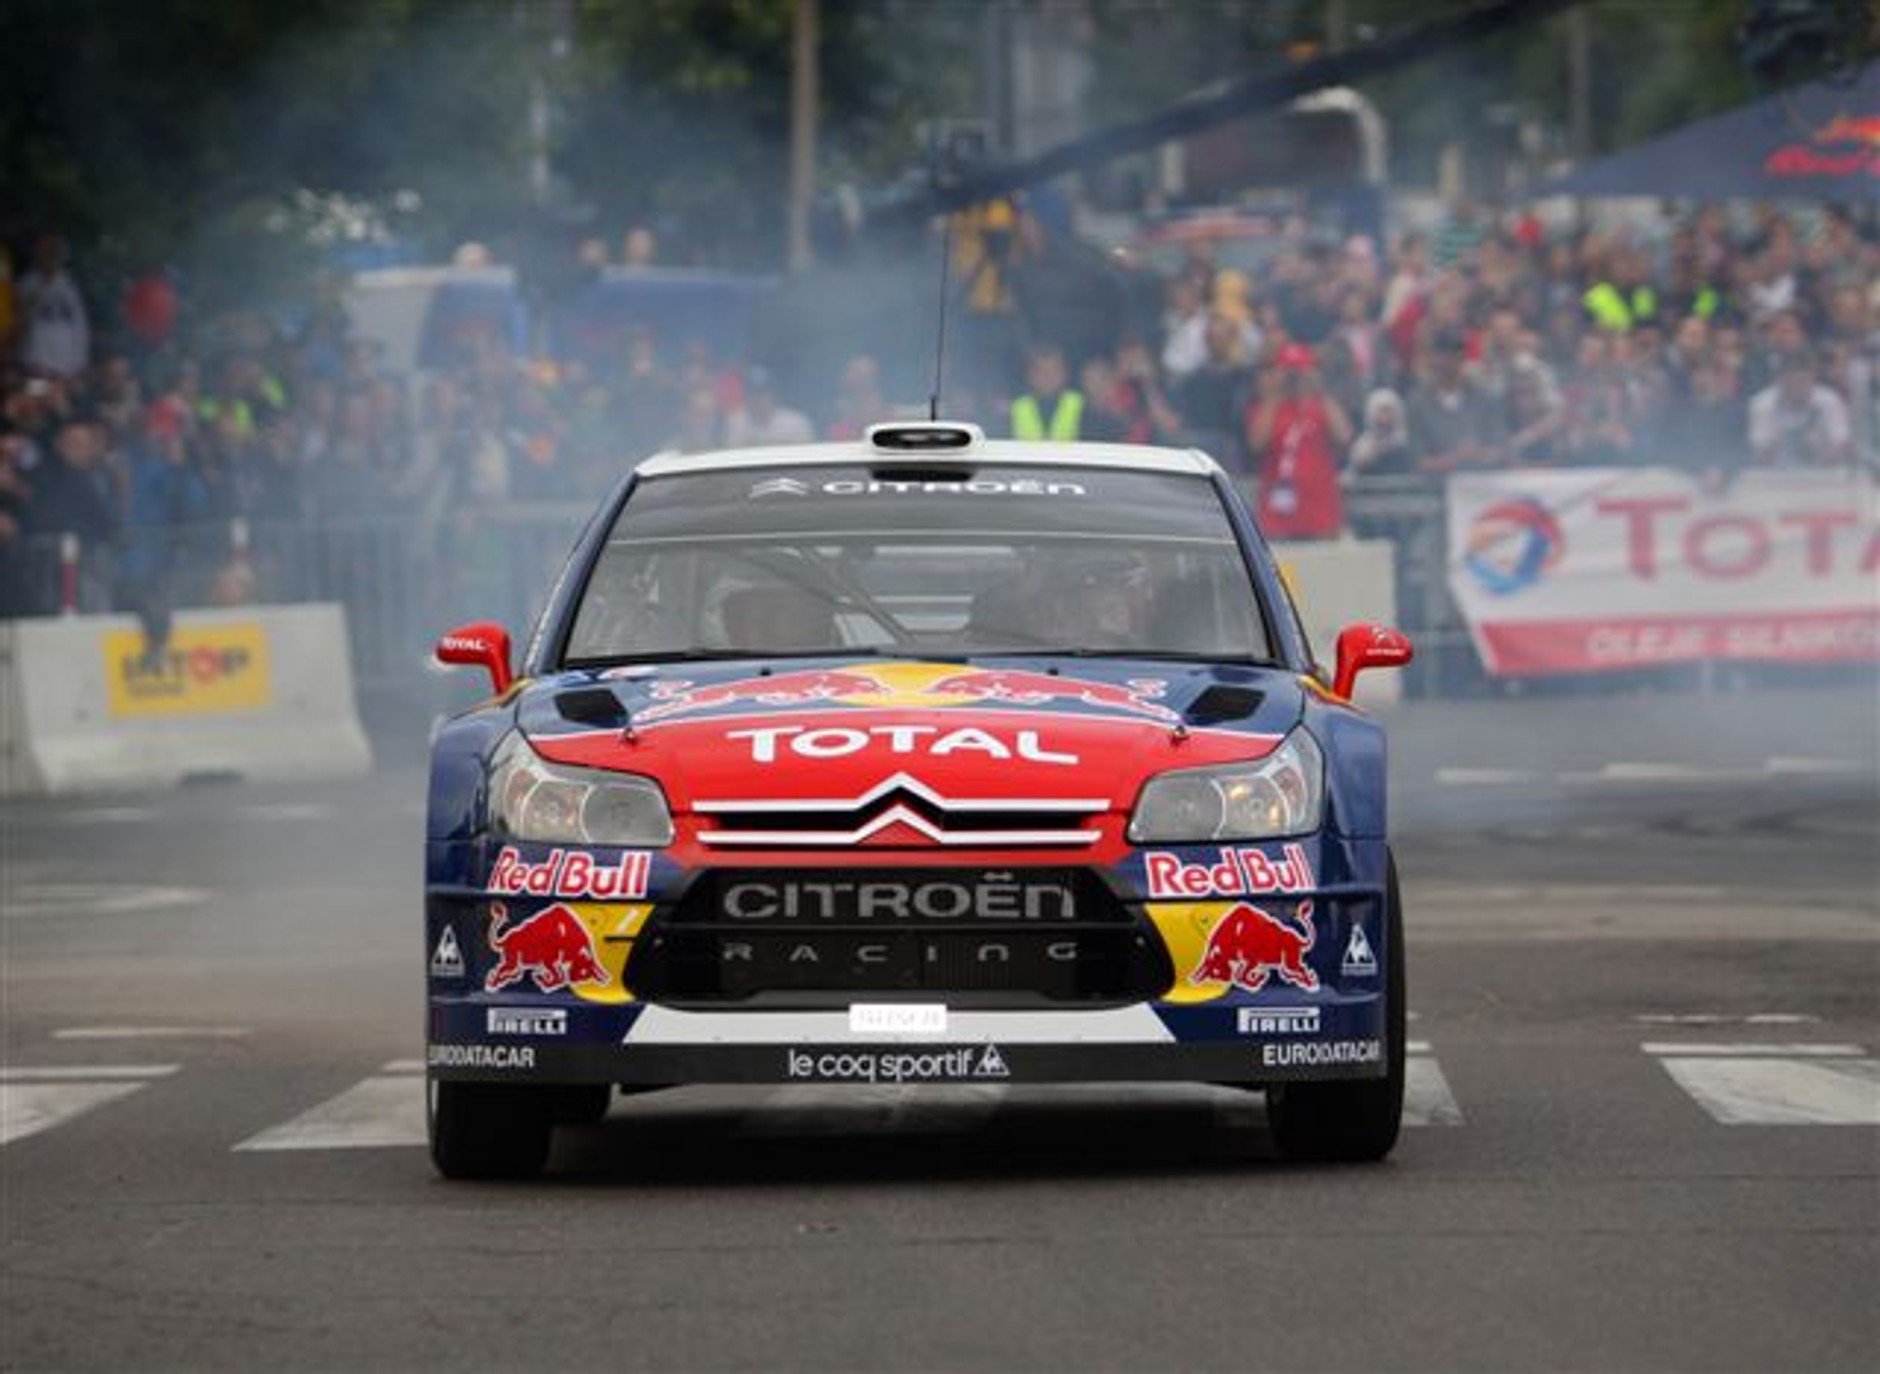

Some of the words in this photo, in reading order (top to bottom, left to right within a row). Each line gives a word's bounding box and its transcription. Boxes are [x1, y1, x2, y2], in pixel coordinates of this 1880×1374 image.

[1595, 494, 1880, 581] TOT
[726, 725, 1080, 764] TOTAL
[487, 846, 563, 895] Red
[556, 850, 652, 898] Bull
[1146, 847, 1245, 897] Red
[1238, 844, 1317, 894] Bull
[487, 1007, 567, 1034] PIRELLI
[1237, 1006, 1320, 1033] PIRELLI
[789, 1049, 814, 1076] le
[817, 1054, 876, 1083] coq
[880, 1049, 973, 1083] sportif
